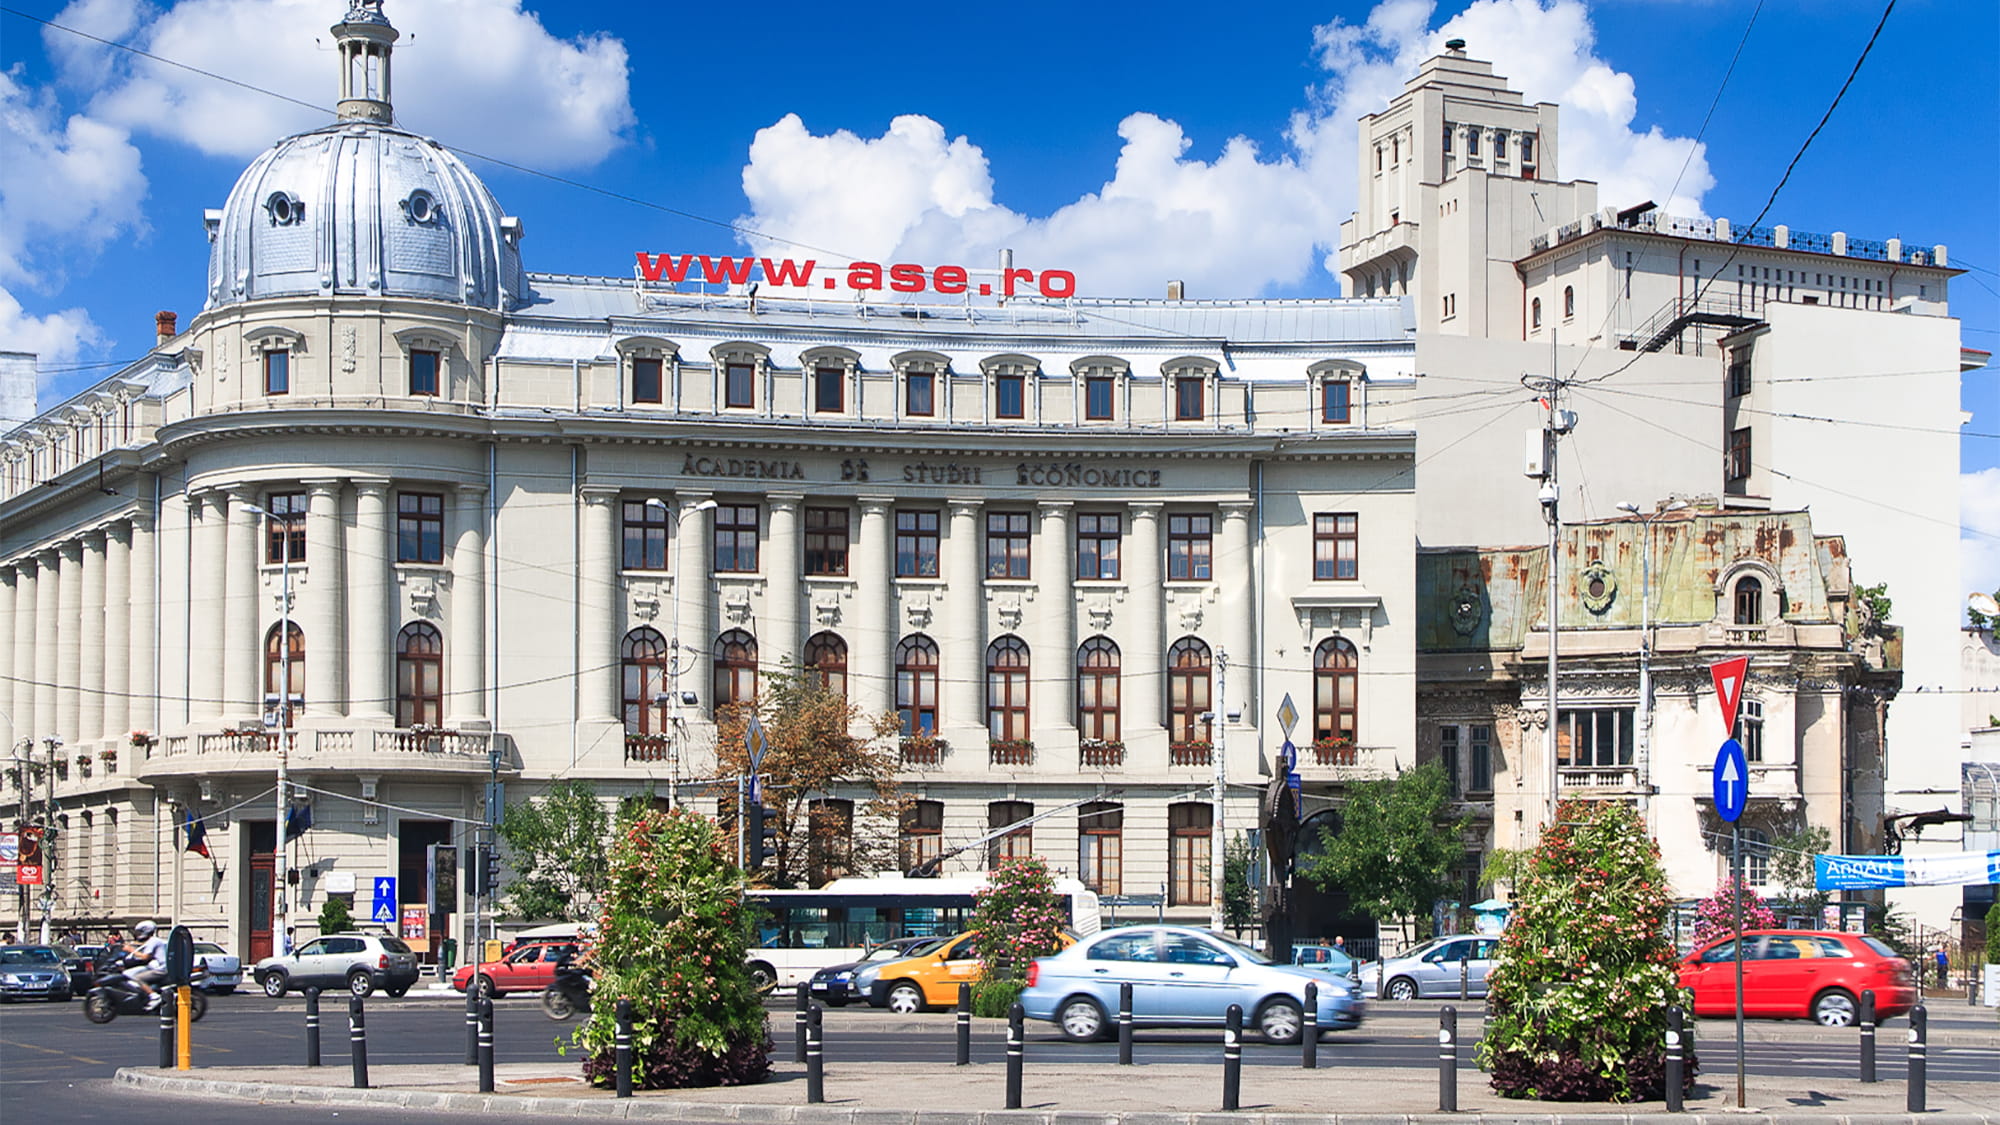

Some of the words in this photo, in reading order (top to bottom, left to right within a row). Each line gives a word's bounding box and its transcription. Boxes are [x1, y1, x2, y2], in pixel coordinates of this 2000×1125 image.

[636, 252, 1076, 298] www.ase.ro
[681, 455, 804, 480] ACADEMIA
[840, 461, 870, 482] DE
[903, 464, 982, 484] STUDII
[1016, 466, 1161, 488] ECONOMICE
